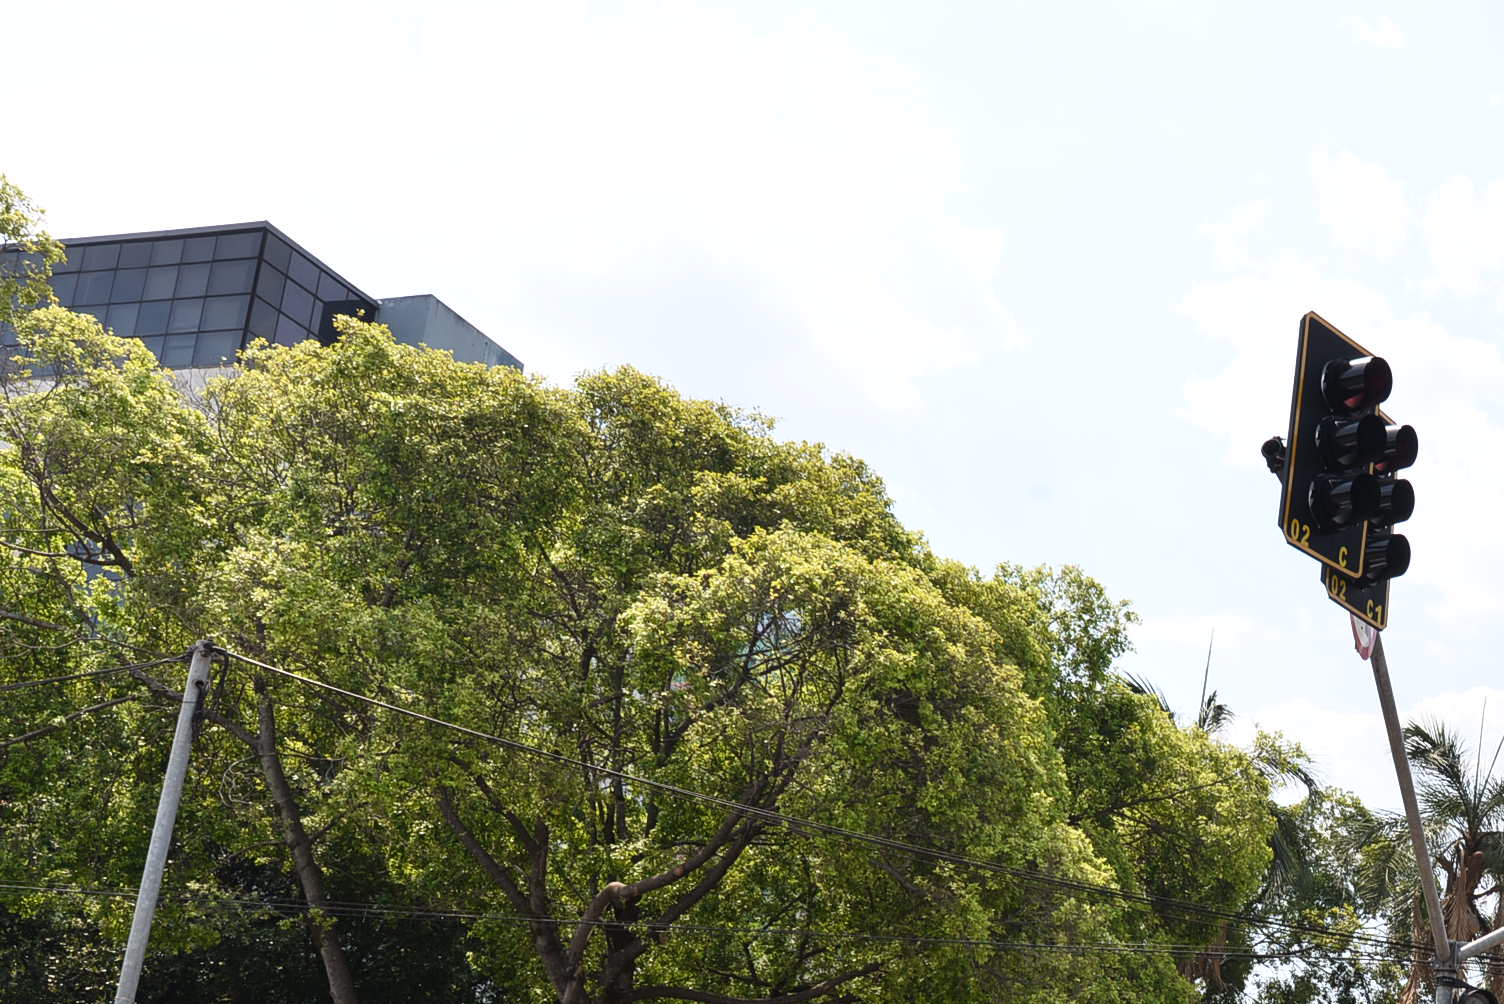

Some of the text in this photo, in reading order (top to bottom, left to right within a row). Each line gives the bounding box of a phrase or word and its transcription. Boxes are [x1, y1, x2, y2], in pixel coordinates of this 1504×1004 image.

[1291, 519, 1348, 567] 02 C
[1332, 576, 1383, 625] 02 C1
